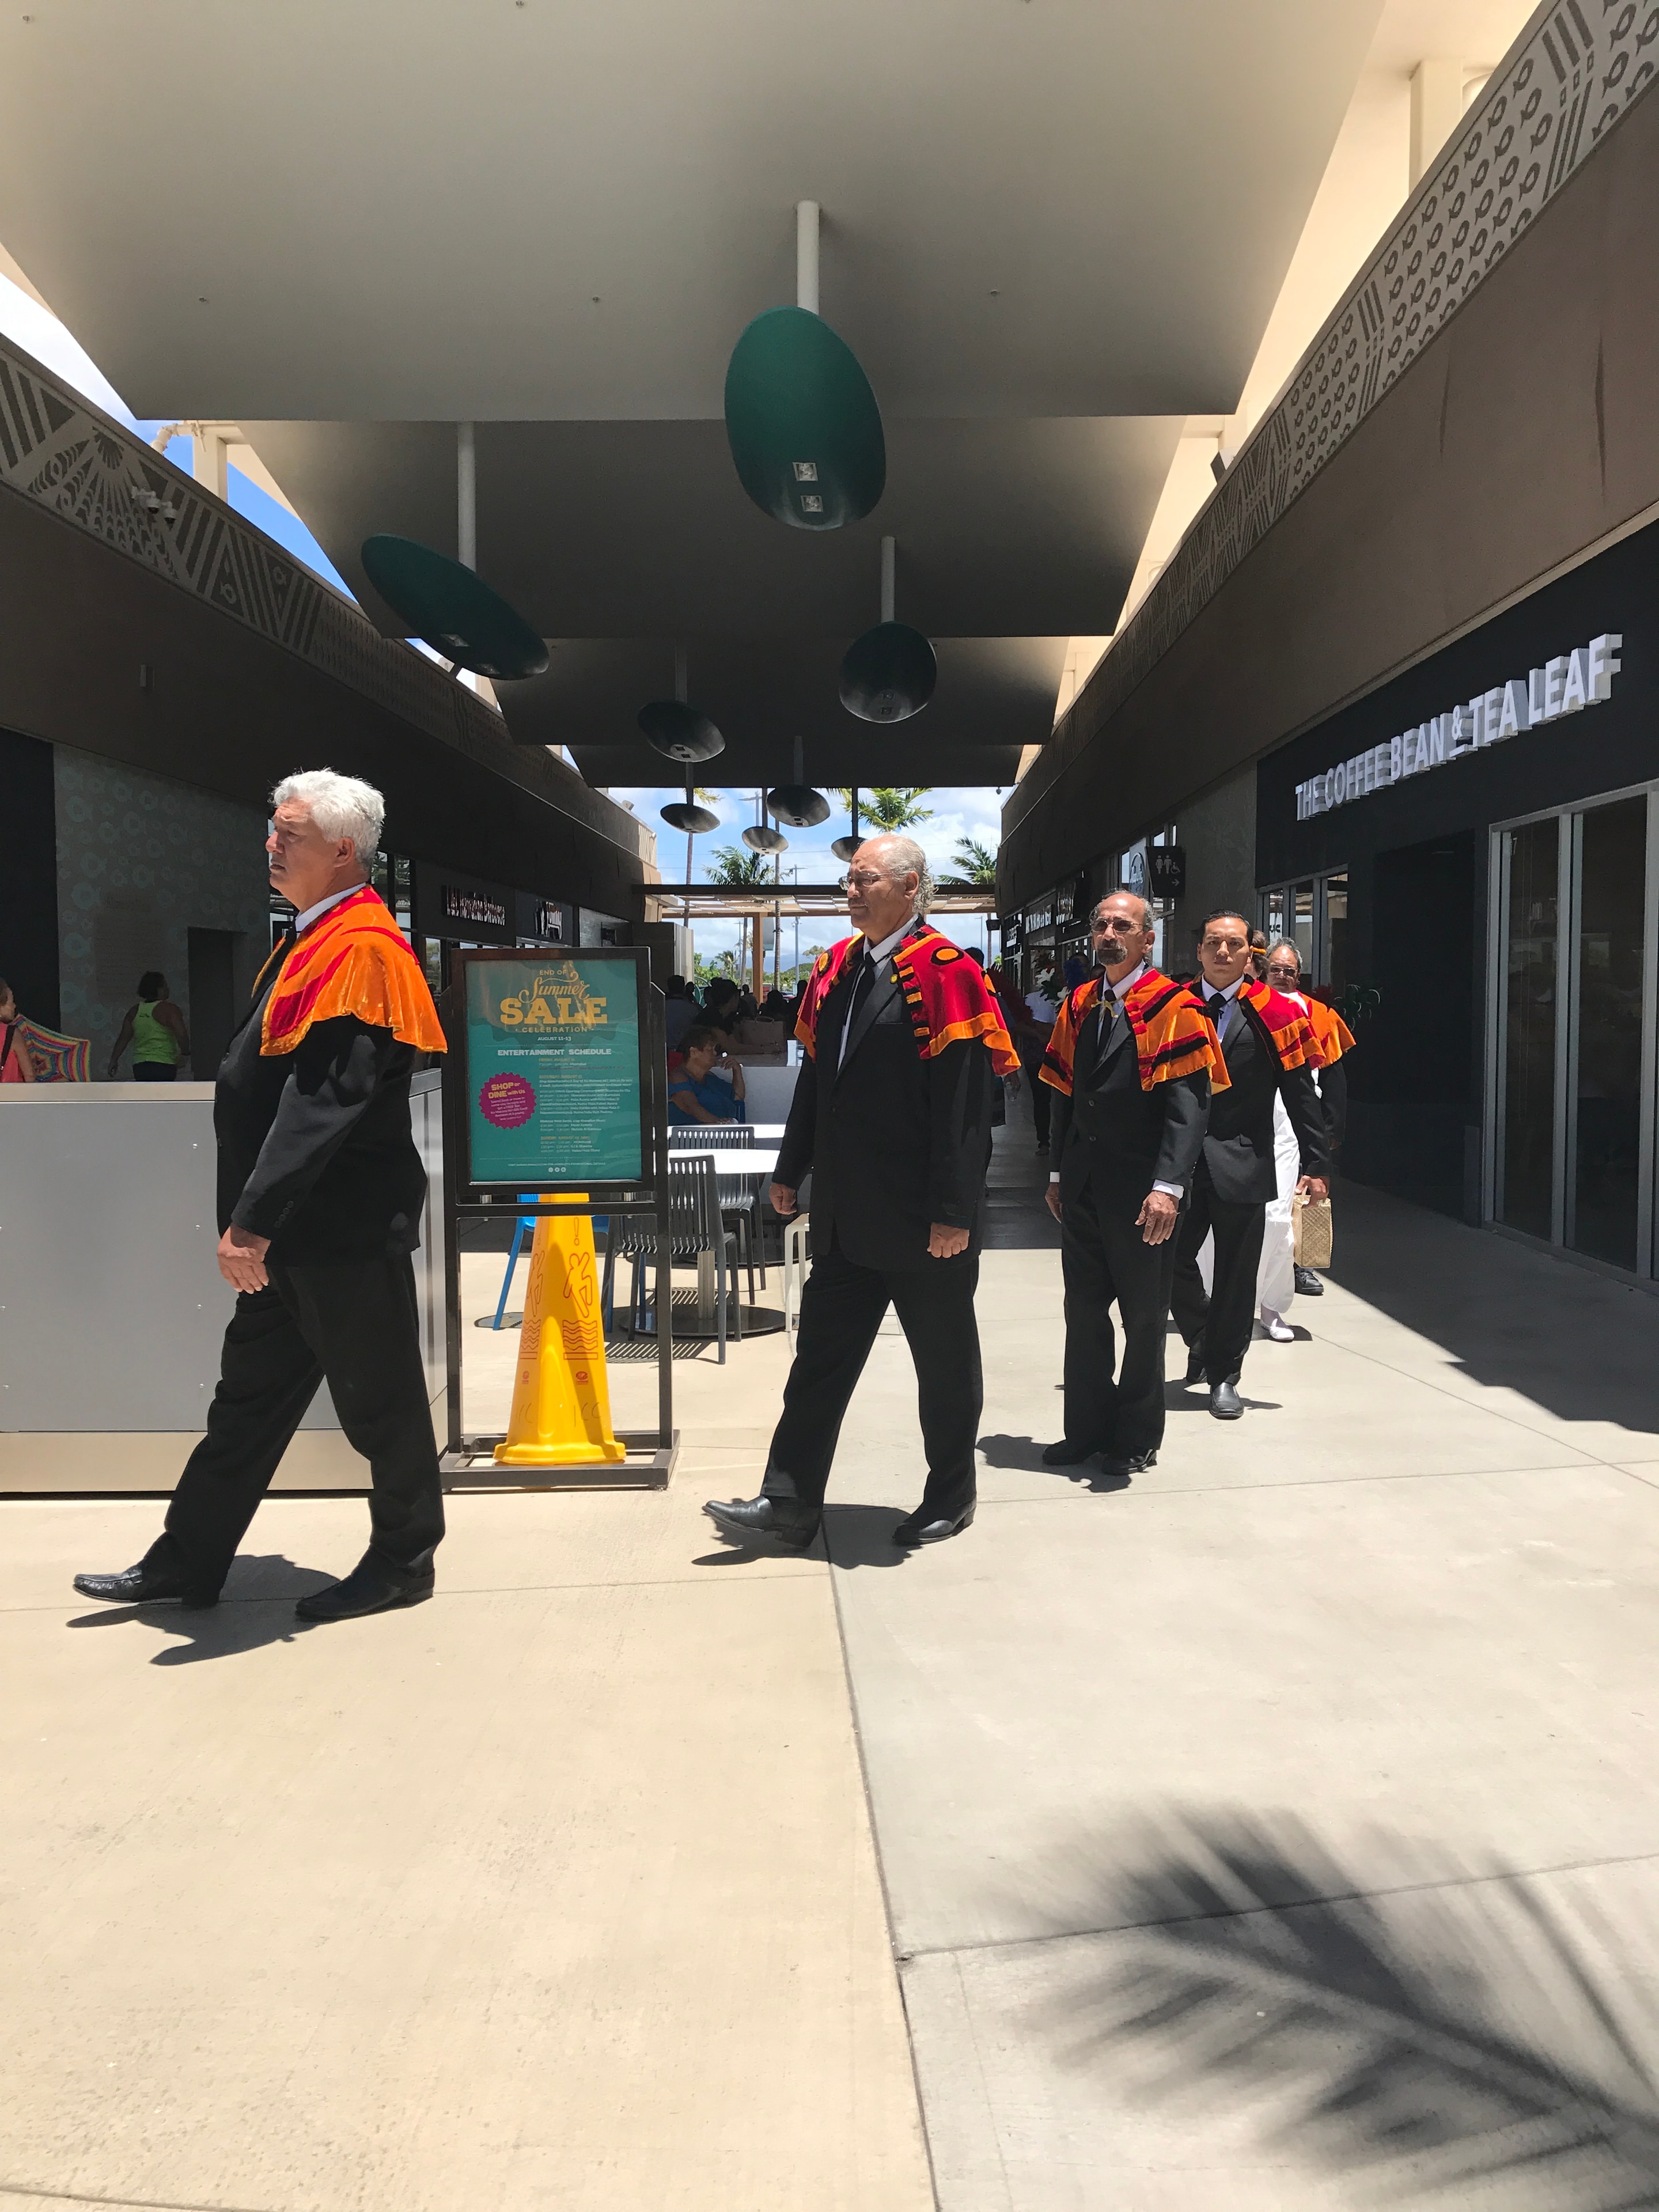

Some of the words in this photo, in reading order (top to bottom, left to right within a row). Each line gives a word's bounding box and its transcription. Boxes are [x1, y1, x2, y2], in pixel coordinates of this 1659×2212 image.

[1295, 775, 1328, 820] THE
[1324, 743, 1395, 809] COFFEE
[1391, 713, 1456, 781] BEAN
[1469, 680, 1532, 748] TEA
[1529, 634, 1623, 725] LEAF
[518, 971, 590, 1003] Summer
[500, 997, 608, 1025] SALE
[488, 1090, 507, 1099] DINE
[491, 1082, 514, 1090] SHOP
